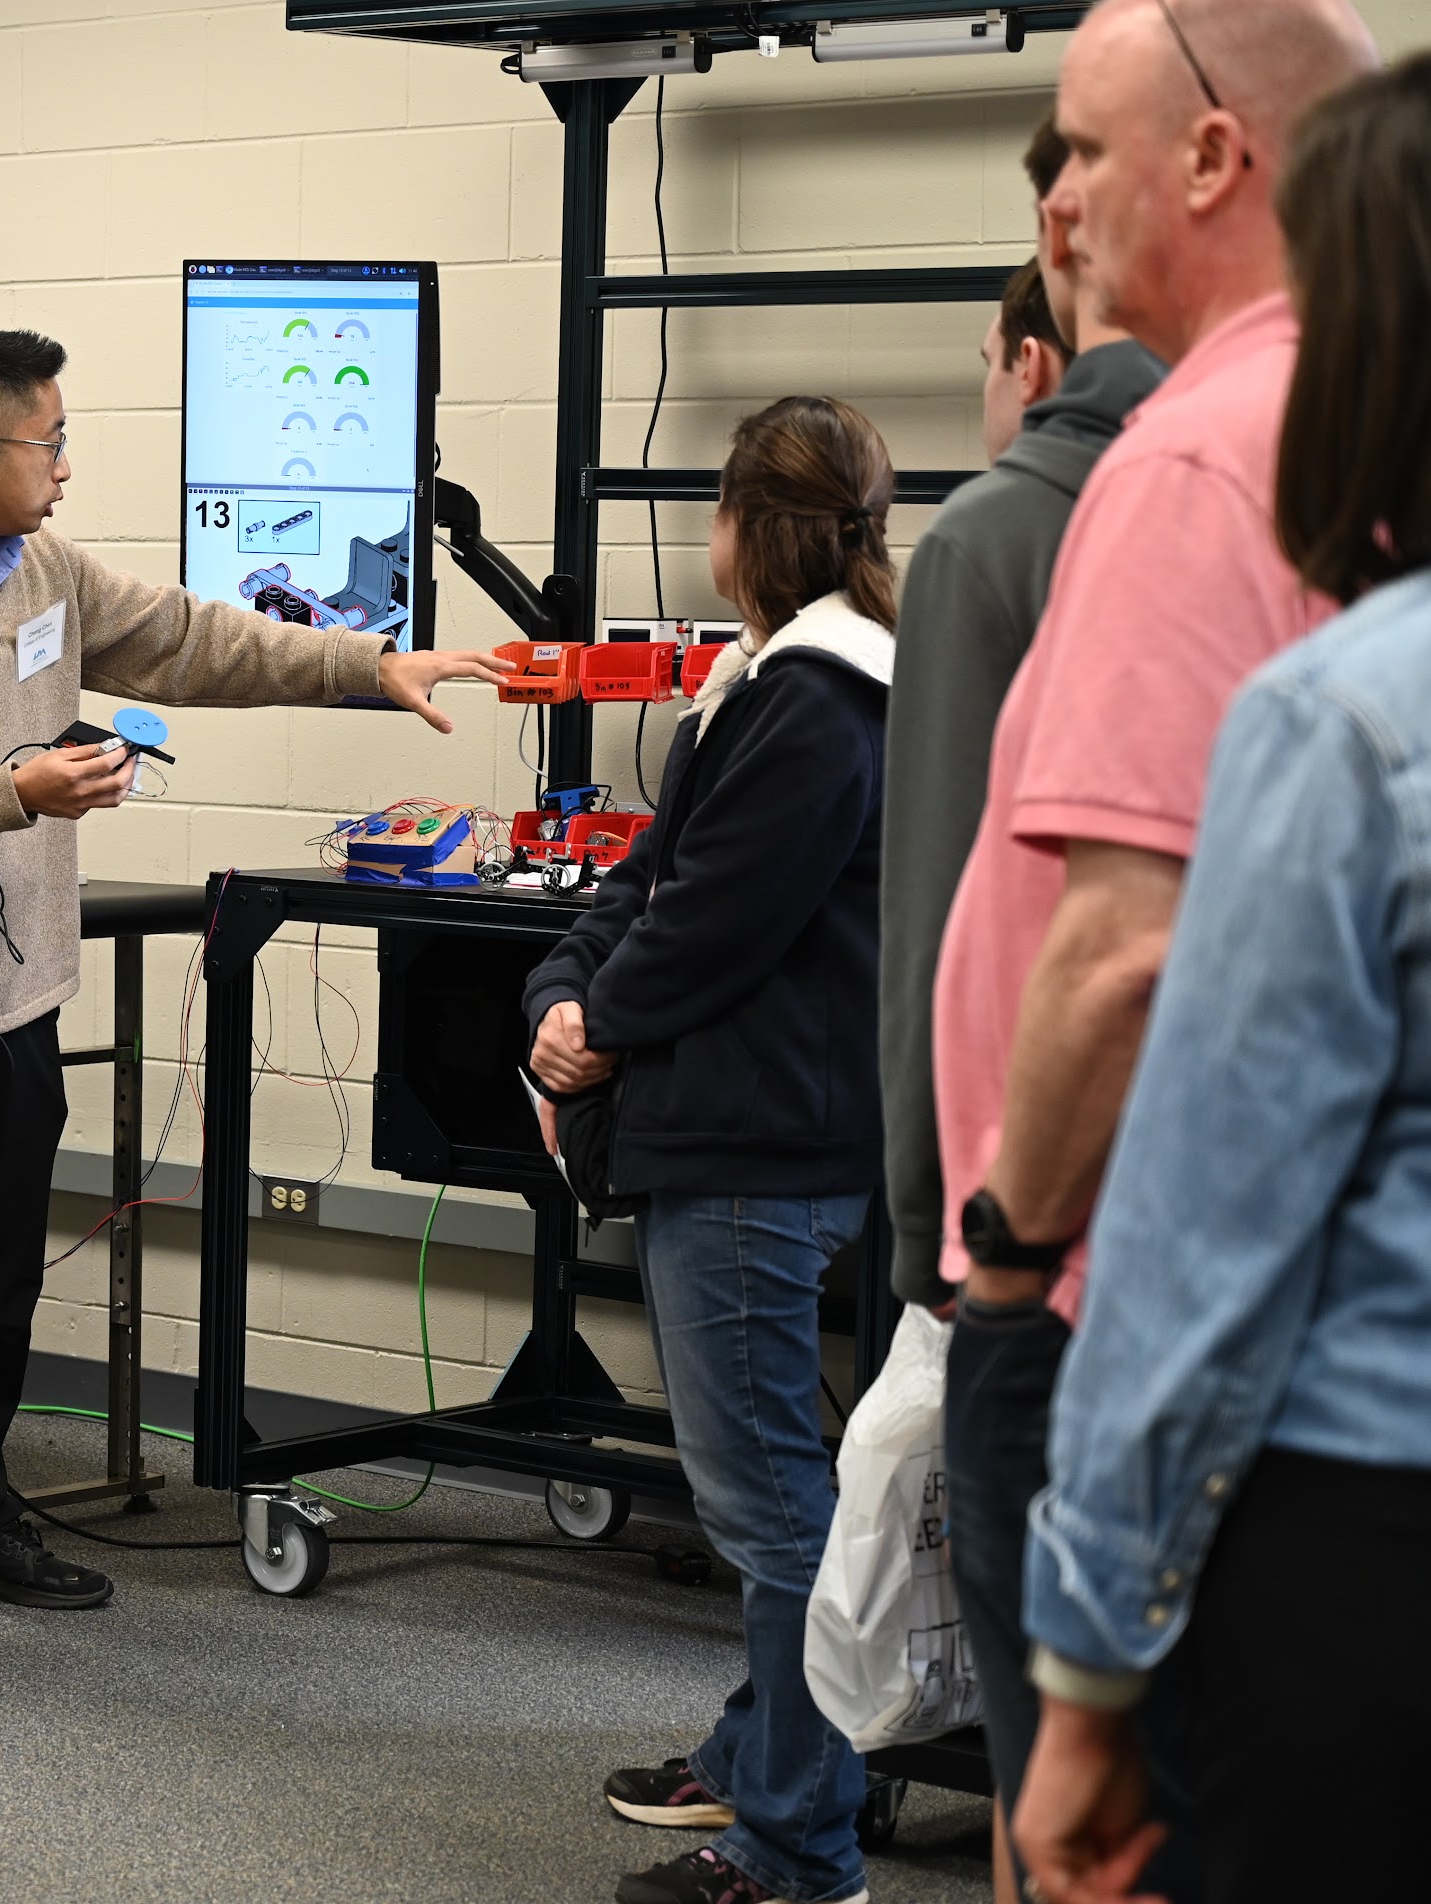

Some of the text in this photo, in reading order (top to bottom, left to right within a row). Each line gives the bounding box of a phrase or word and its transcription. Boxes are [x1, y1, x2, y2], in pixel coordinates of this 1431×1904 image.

[195, 500, 230, 528] 13
[244, 535, 254, 543] 3x
[506, 686, 523, 697] Bin
[539, 687, 554, 698] 103
[595, 682, 607, 693] Bin
